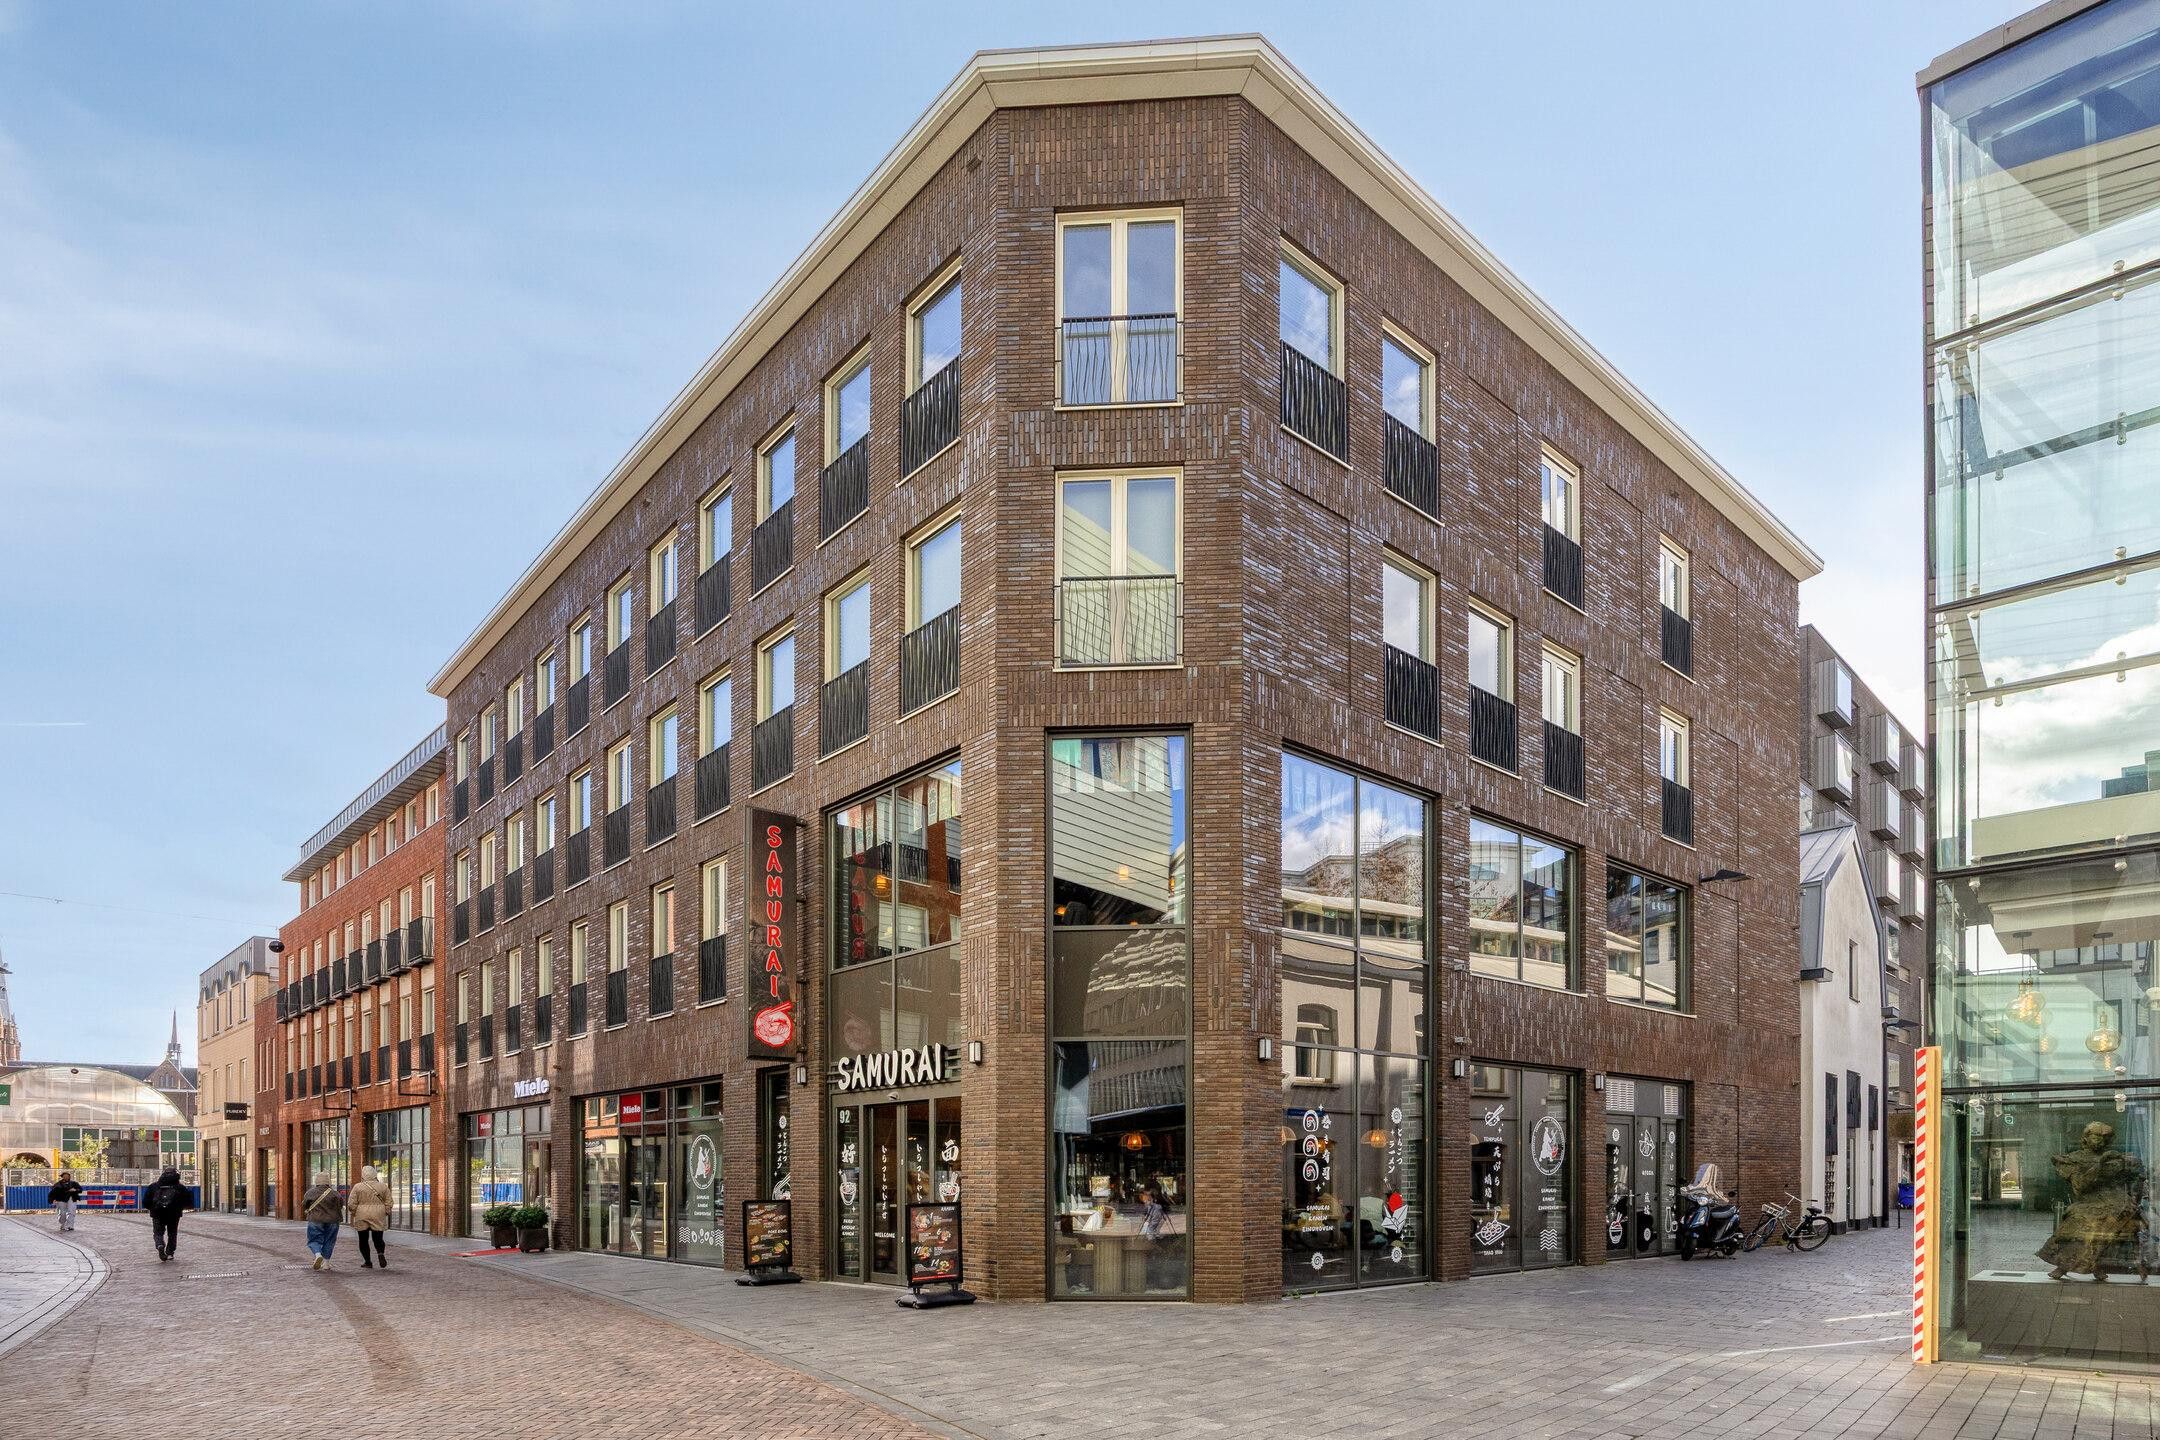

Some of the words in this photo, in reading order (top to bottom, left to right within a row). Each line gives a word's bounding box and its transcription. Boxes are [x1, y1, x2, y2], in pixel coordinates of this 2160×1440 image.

[766, 825, 783, 998] SAMURAI
[838, 1042, 942, 1090] SAMURAI
[514, 1077, 550, 1099] Miele
[623, 1105, 641, 1114] Miele
[840, 1110, 850, 1124] 92
[480, 1122, 491, 1130] Miele
